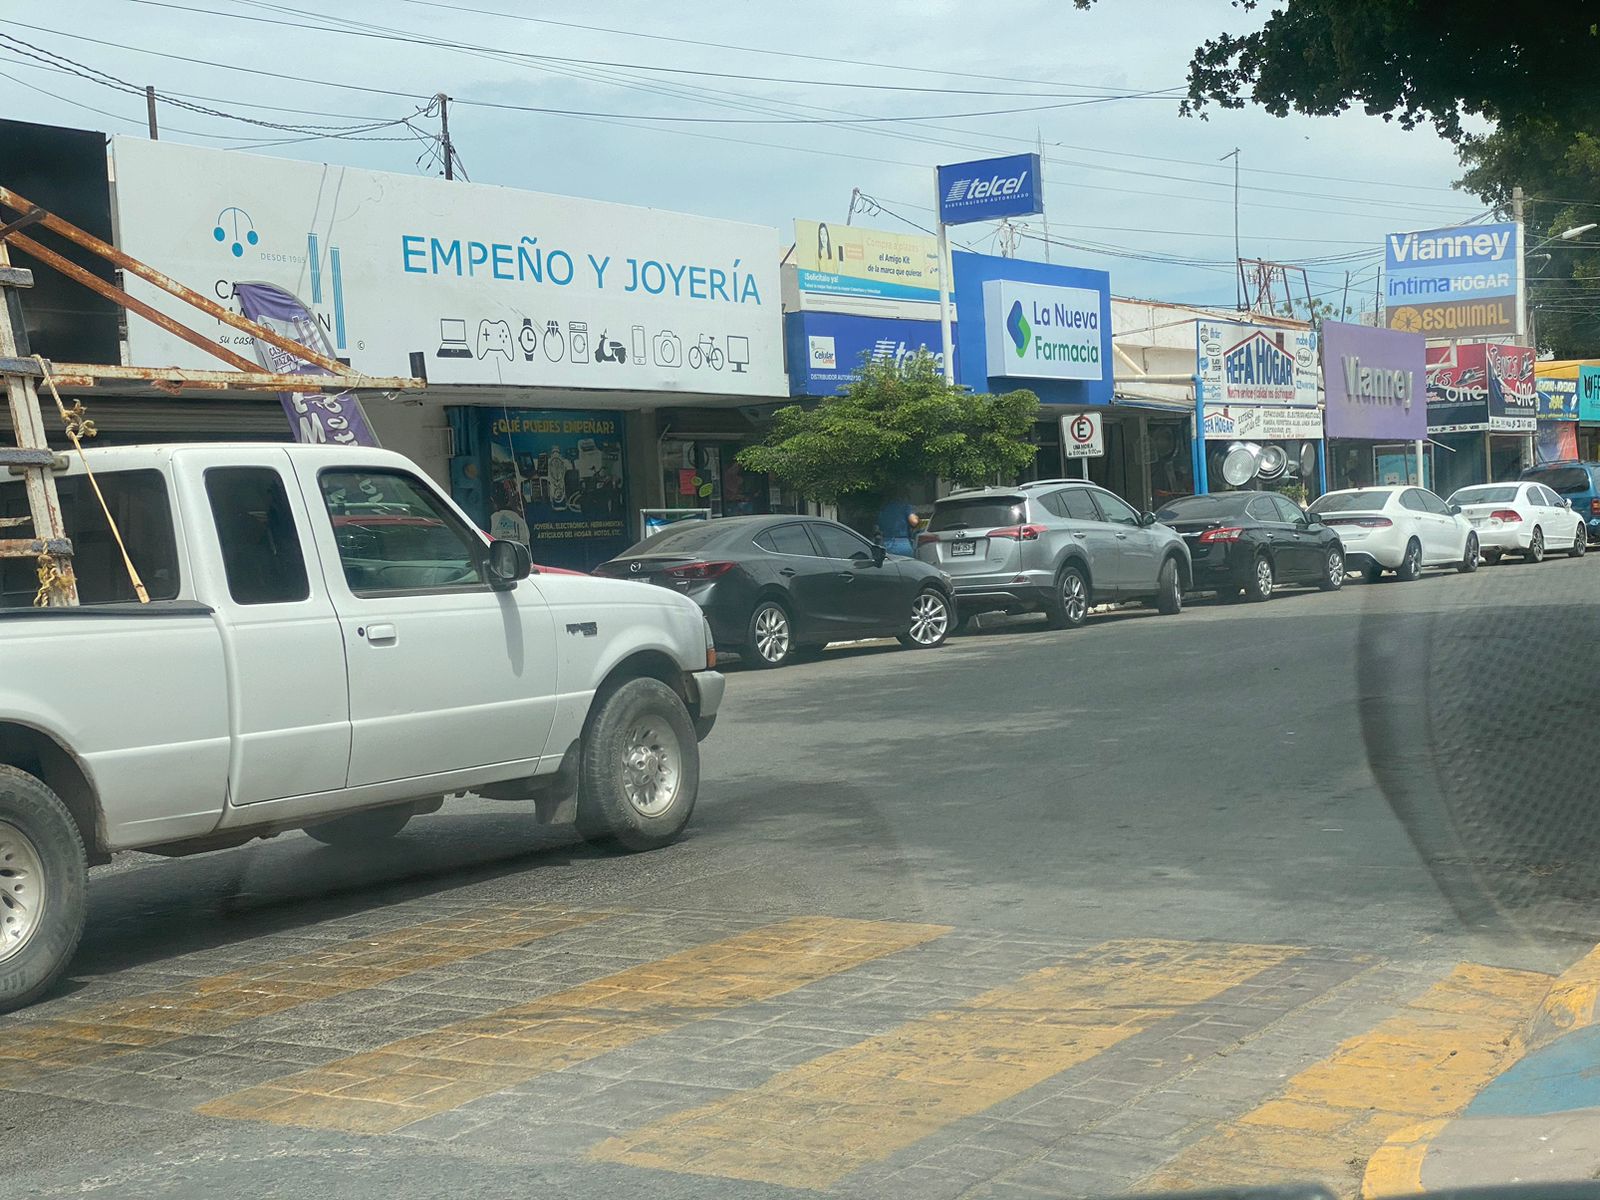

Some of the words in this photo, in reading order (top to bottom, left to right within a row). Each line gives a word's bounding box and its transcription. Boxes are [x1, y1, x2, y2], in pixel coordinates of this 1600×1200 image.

[966, 170, 1028, 199] telcel
[990, 192, 1029, 202] AUTORIZADO
[1390, 231, 1510, 262] Vianney
[260, 252, 287, 262] DESDE
[885, 254, 902, 264] Amigo
[401, 234, 575, 286] EMPEÑO
[588, 254, 611, 289] Y
[624, 258, 762, 306] JOYERÍA
[867, 264, 874, 272] de
[880, 266, 895, 275] marca
[896, 269, 905, 277] que
[1033, 300, 1052, 326] La
[1054, 303, 1098, 331] Nueva
[1421, 303, 1510, 331] ESQUIMAL
[219, 335, 230, 344] su
[233, 333, 255, 346] casa
[1034, 335, 1099, 363] Farmacia
[814, 350, 834, 360] Celular
[1225, 342, 1254, 385] REFA
[1255, 337, 1294, 386] HOGAR
[1341, 354, 1414, 412] Vianney
[1446, 385, 1484, 402] one
[1515, 381, 1534, 407] one
[492, 416, 521, 435] ¿QUÉ
[523, 420, 561, 433] PUEDES
[563, 418, 615, 434] EMPEÑAR?
[1077, 421, 1087, 438] E
[1204, 417, 1214, 434] EFA
